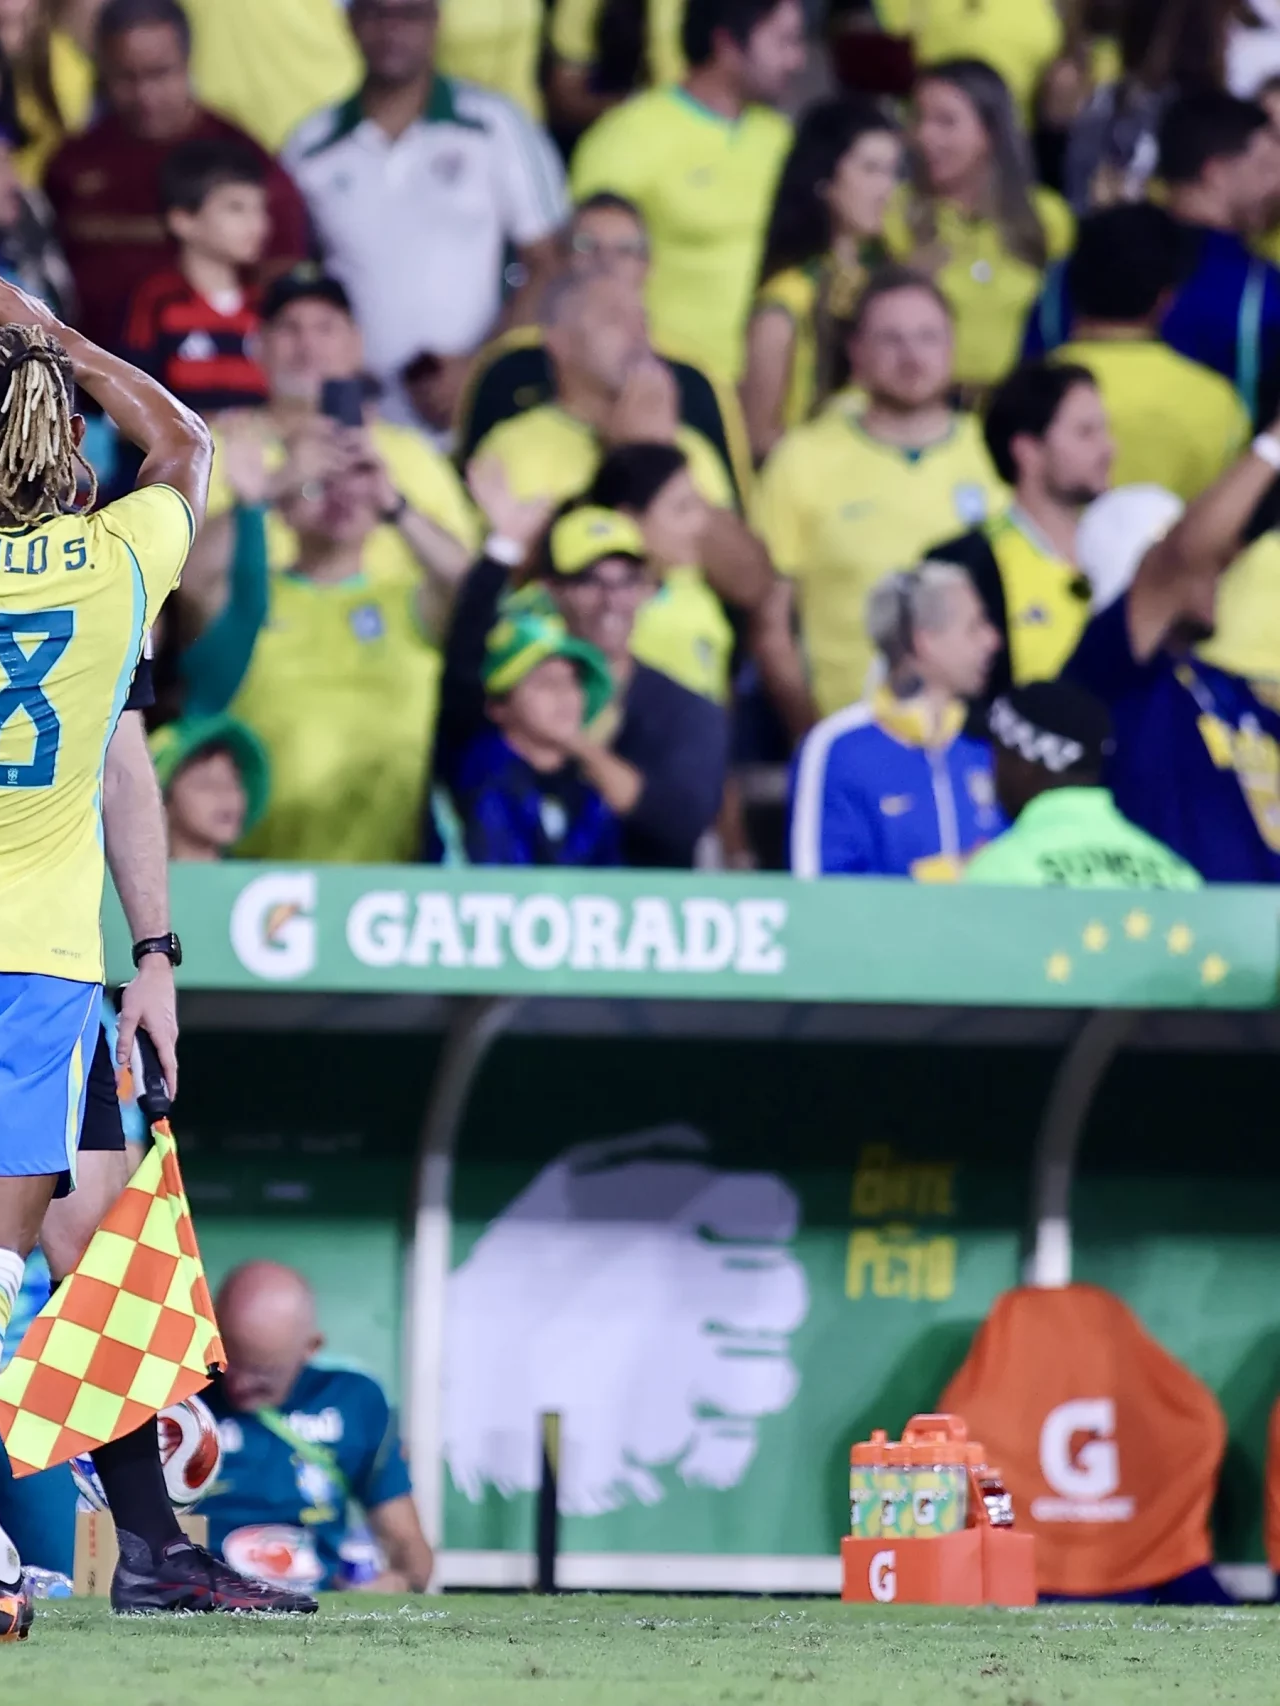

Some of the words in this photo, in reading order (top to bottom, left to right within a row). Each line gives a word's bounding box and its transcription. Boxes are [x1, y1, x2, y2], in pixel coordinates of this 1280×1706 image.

[63, 536, 95, 571] S.
[229, 870, 317, 981] G
[346, 890, 786, 973] GATORADE
[1040, 1398, 1120, 1497] G
[869, 1551, 897, 1602] G
